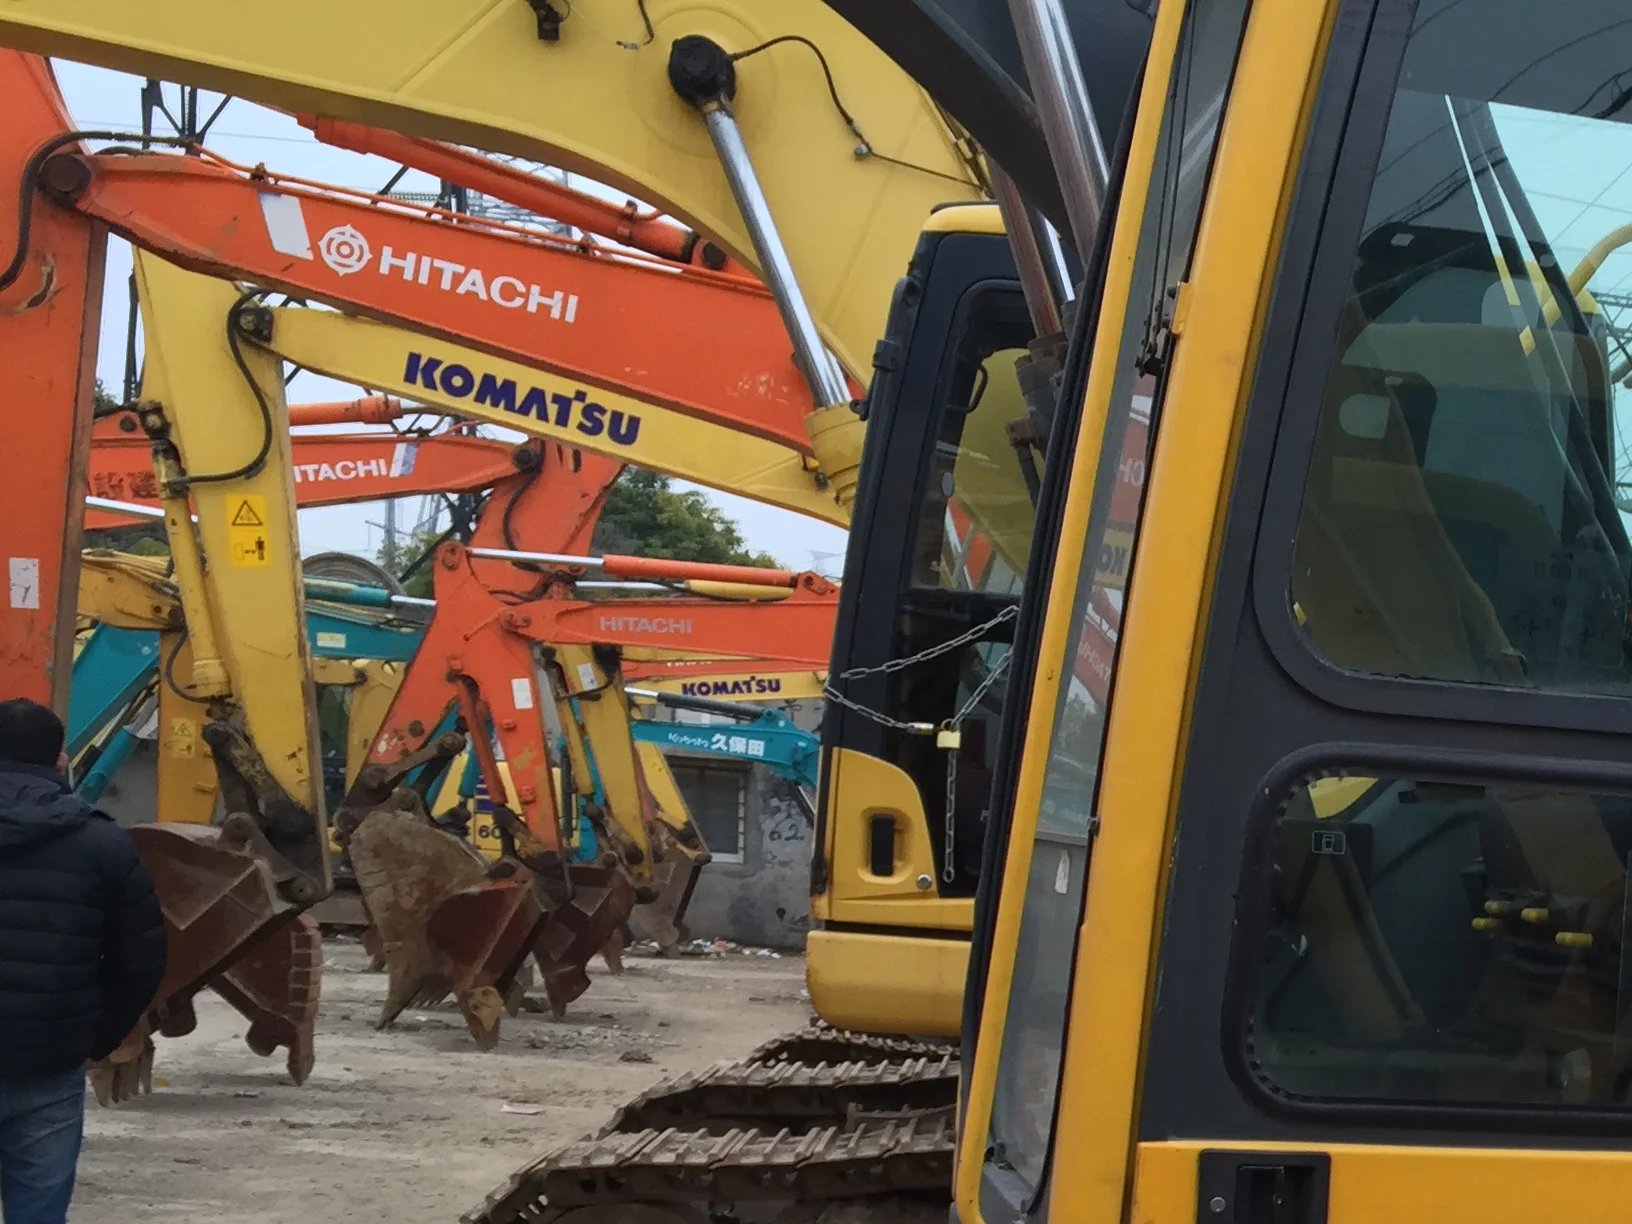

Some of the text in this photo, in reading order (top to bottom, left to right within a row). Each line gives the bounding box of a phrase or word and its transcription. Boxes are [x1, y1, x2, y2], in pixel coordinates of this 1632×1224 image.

[380, 246, 578, 323] HITACHI
[404, 352, 641, 445] KOMATSU
[292, 459, 387, 483] ITACHI
[600, 617, 692, 634] HITACHI
[681, 676, 781, 696] KOMATSU
[711, 733, 765, 757] 久保田
